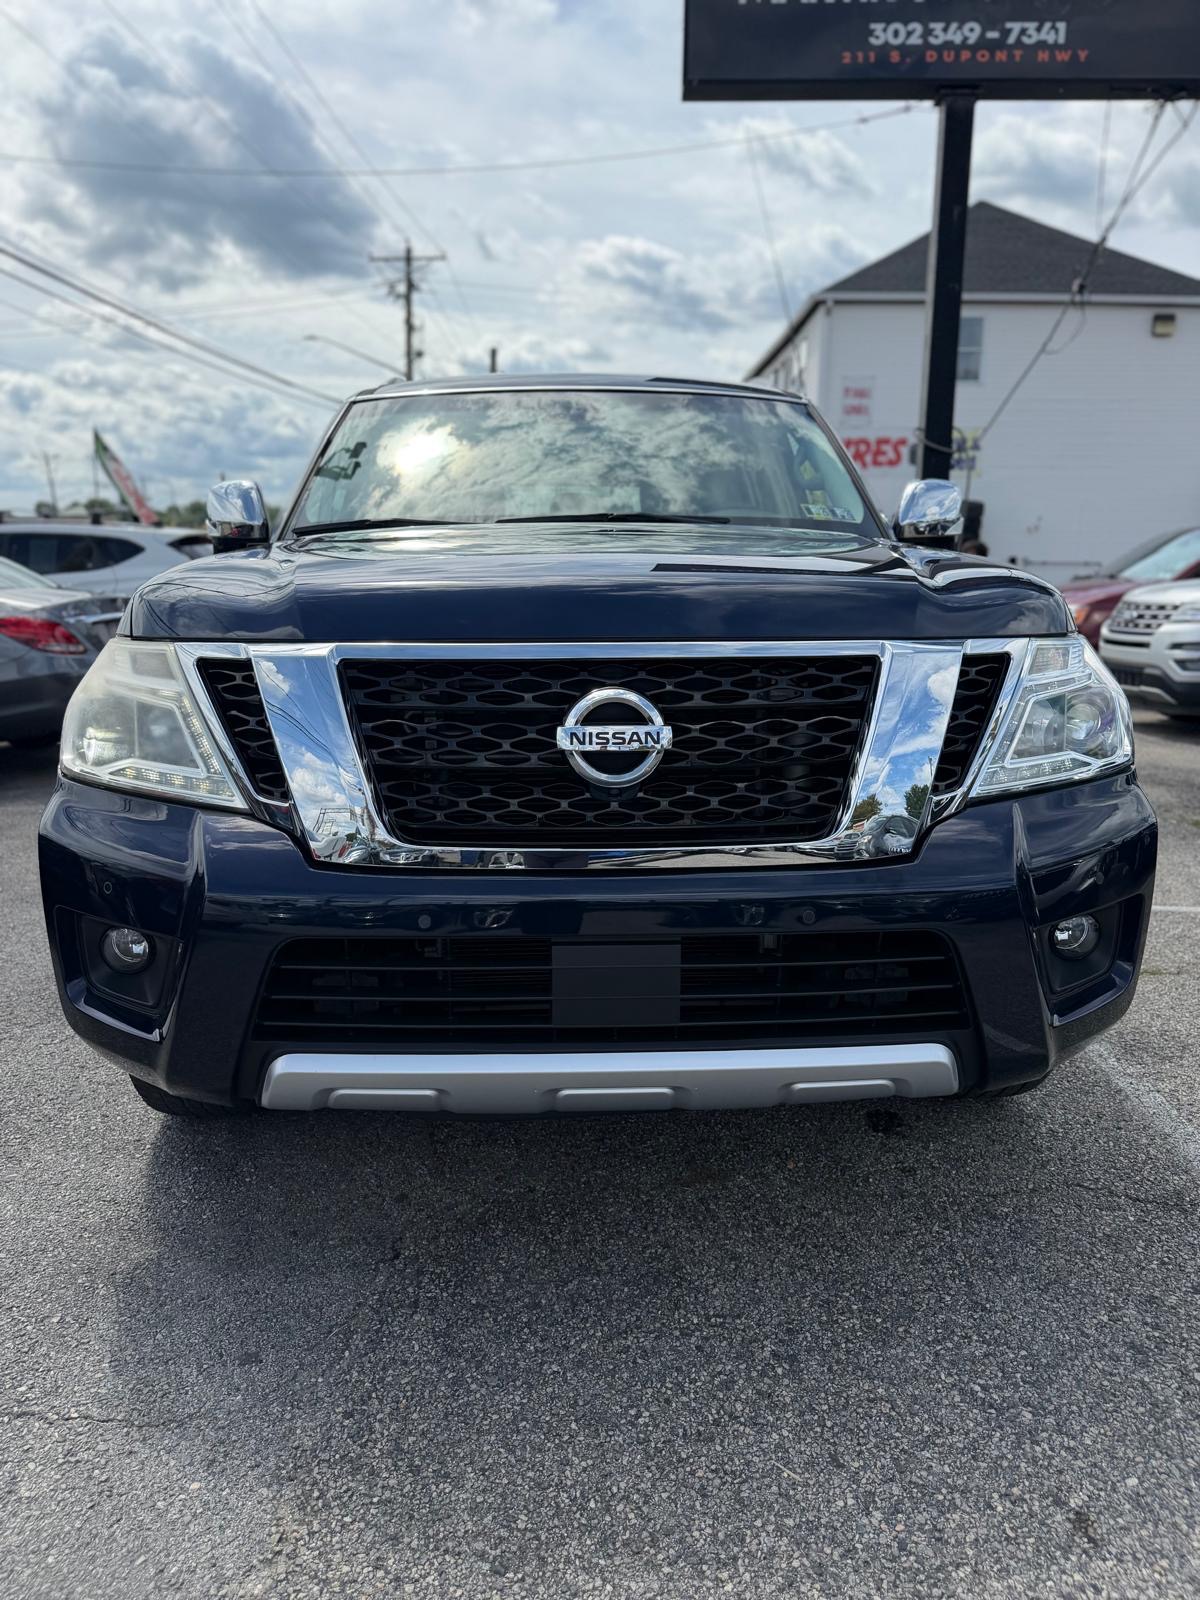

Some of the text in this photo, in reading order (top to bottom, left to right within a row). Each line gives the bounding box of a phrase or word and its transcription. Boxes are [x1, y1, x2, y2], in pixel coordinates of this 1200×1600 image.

[868, 22, 923, 45] 302
[841, 51, 876, 64] 211
[924, 49, 1023, 63] DUPONT
[1036, 49, 1088, 62] HWY
[569, 731, 660, 746] NISSAN
